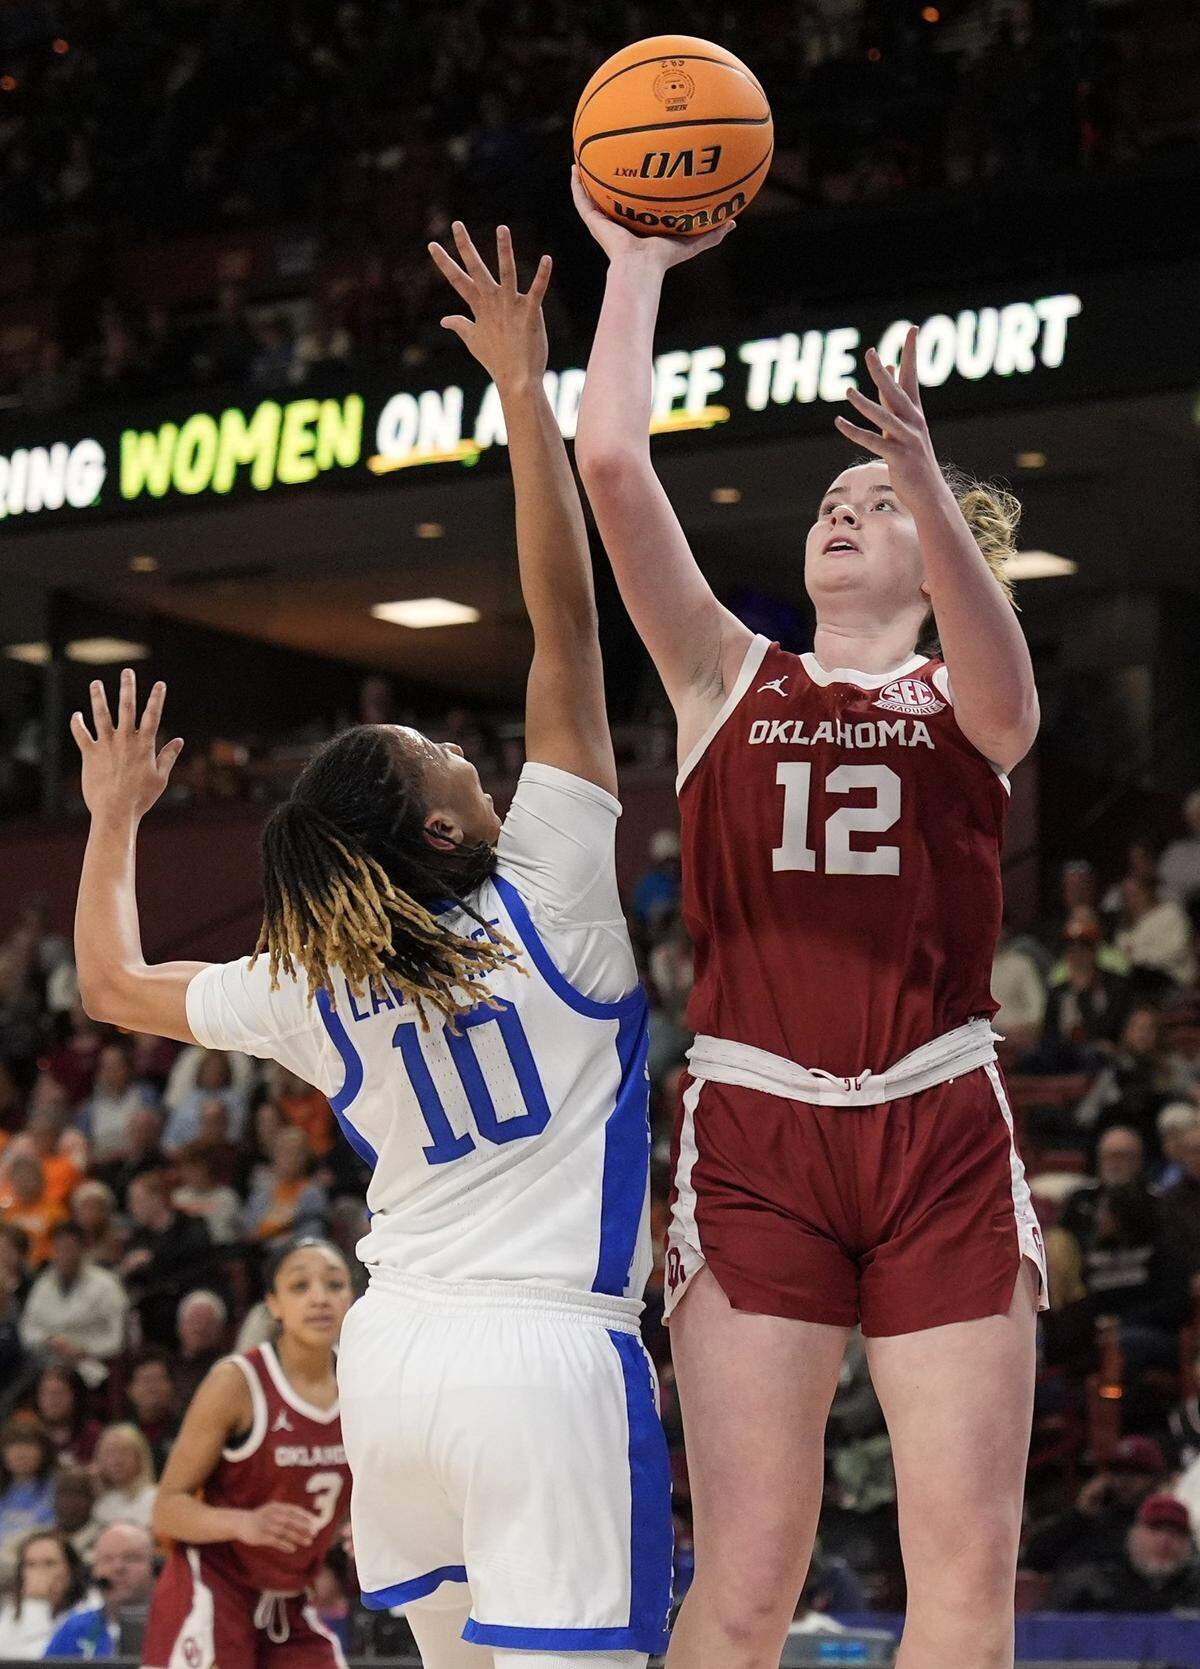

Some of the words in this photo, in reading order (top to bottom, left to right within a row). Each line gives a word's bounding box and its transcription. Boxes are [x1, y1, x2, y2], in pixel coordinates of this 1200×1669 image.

[612, 167, 638, 178] NXT
[639, 145, 722, 179] EVO
[612, 191, 746, 233] Wilson
[119, 393, 365, 499] WOMEN
[376, 385, 465, 458] ON
[474, 369, 587, 448] AD
[651, 347, 727, 418] FF
[738, 327, 860, 411] THE
[877, 294, 1083, 387] COURT
[883, 681, 933, 705] SEC
[748, 719, 936, 750] OKLAHOMA
[772, 761, 902, 876] 12
[391, 995, 552, 1166] 10
[305, 1472, 344, 1536] 3
